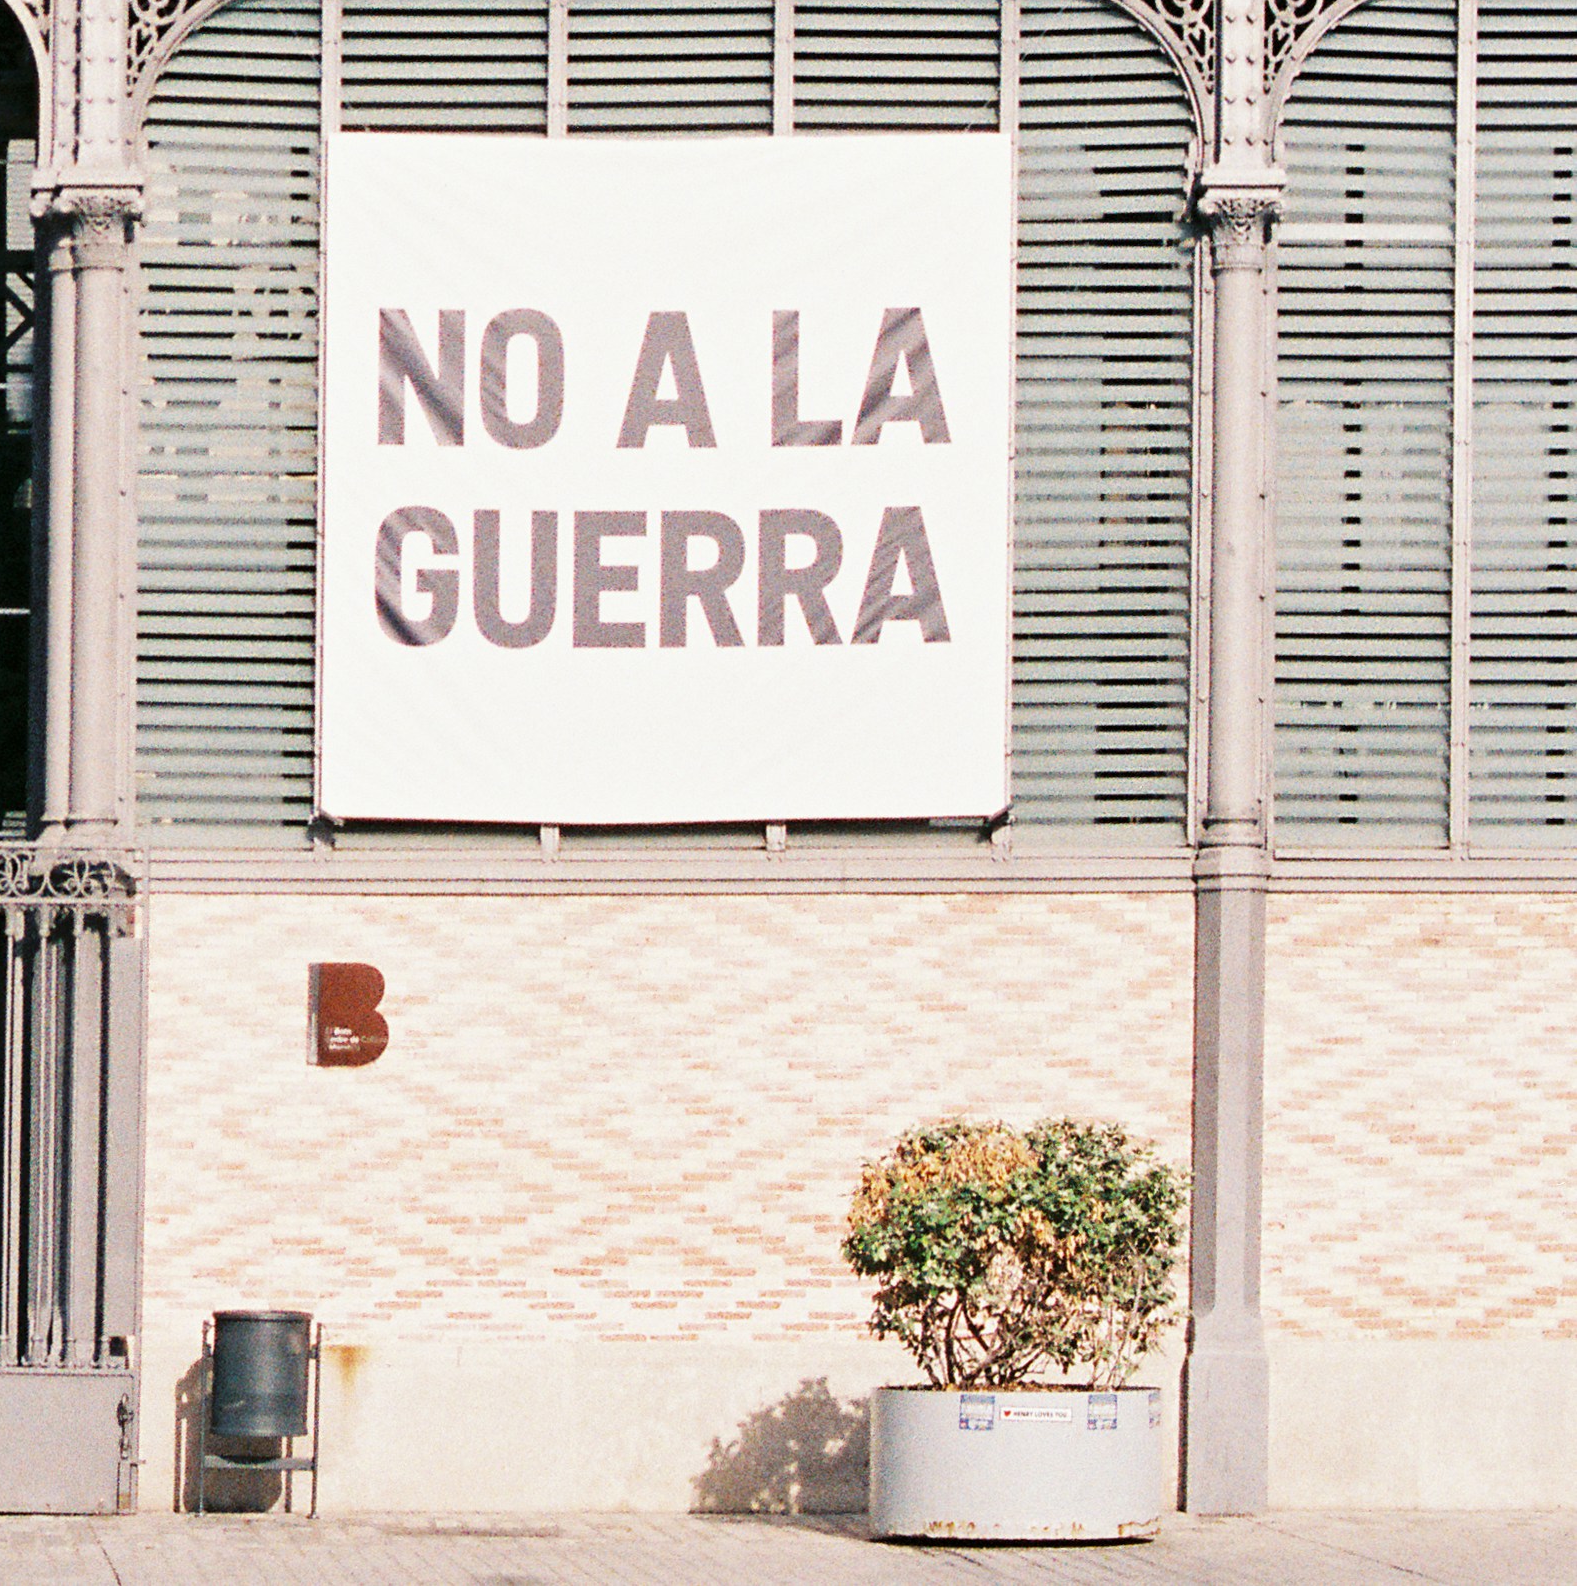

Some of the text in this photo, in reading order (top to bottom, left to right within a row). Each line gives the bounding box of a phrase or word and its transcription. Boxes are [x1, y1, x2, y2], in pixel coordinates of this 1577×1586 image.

[377, 307, 952, 449] NO A LA
[374, 505, 952, 649] GUERRA
